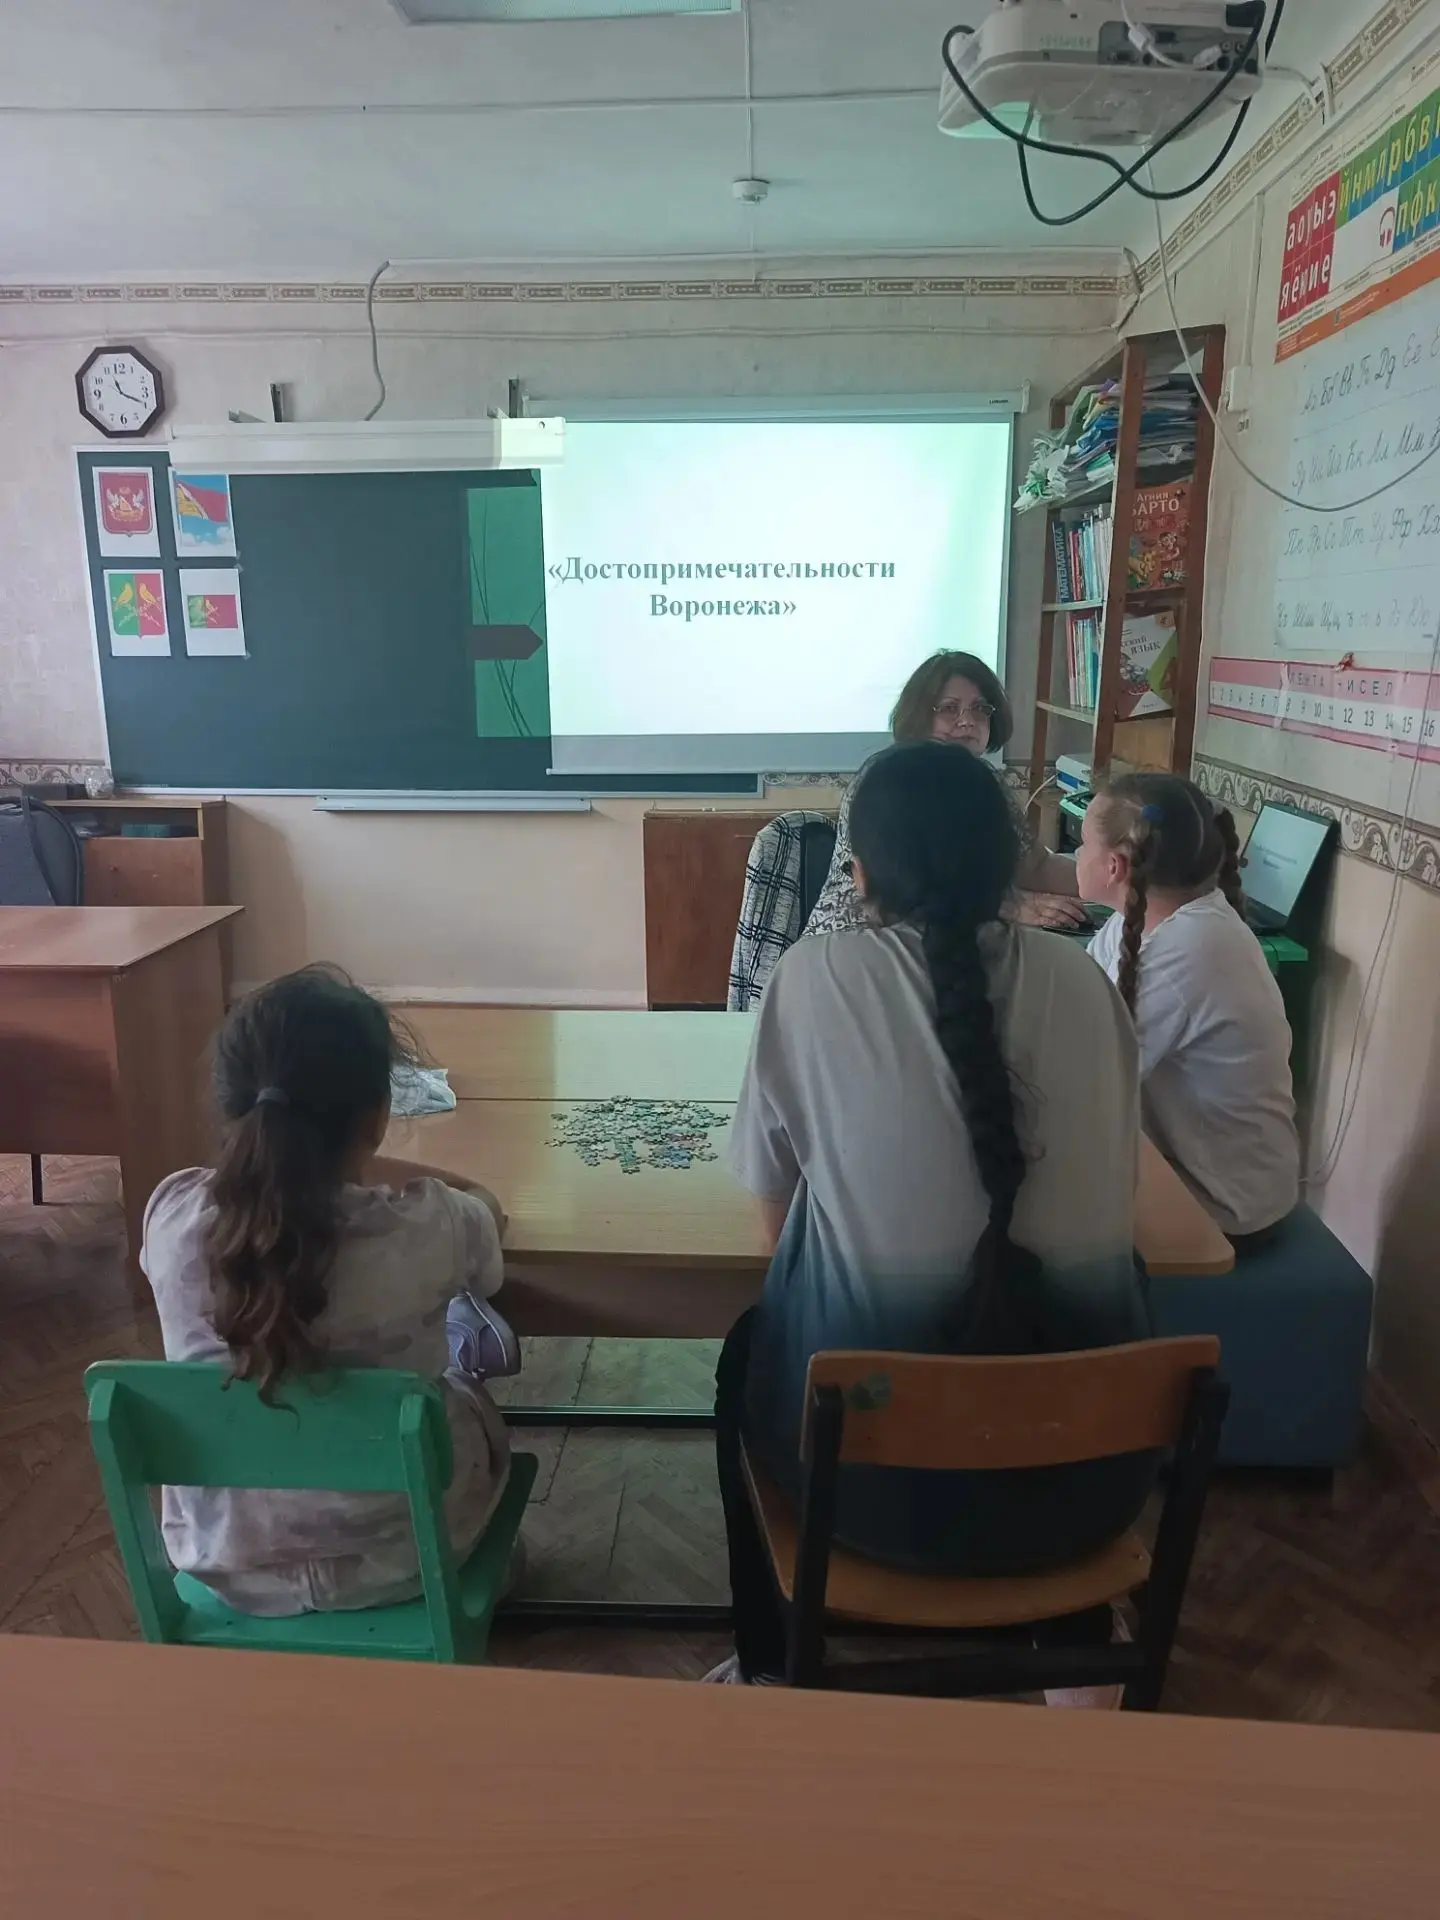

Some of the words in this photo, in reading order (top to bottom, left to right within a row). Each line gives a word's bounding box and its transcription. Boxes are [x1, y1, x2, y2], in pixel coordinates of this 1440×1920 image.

[113, 363, 126, 374] 12
[94, 377, 104, 386] 10
[93, 389, 102, 400] 9
[141, 386, 149, 399] 3
[120, 414, 128, 425] 6
[548, 556, 896, 585] «Достопримечательности
[649, 594, 797, 622] Воронежа»
[1343, 707, 1354, 723] 12
[1364, 710, 1375, 727] 13
[1402, 716, 1413, 734] 15
[1424, 716, 1436, 737] 16
